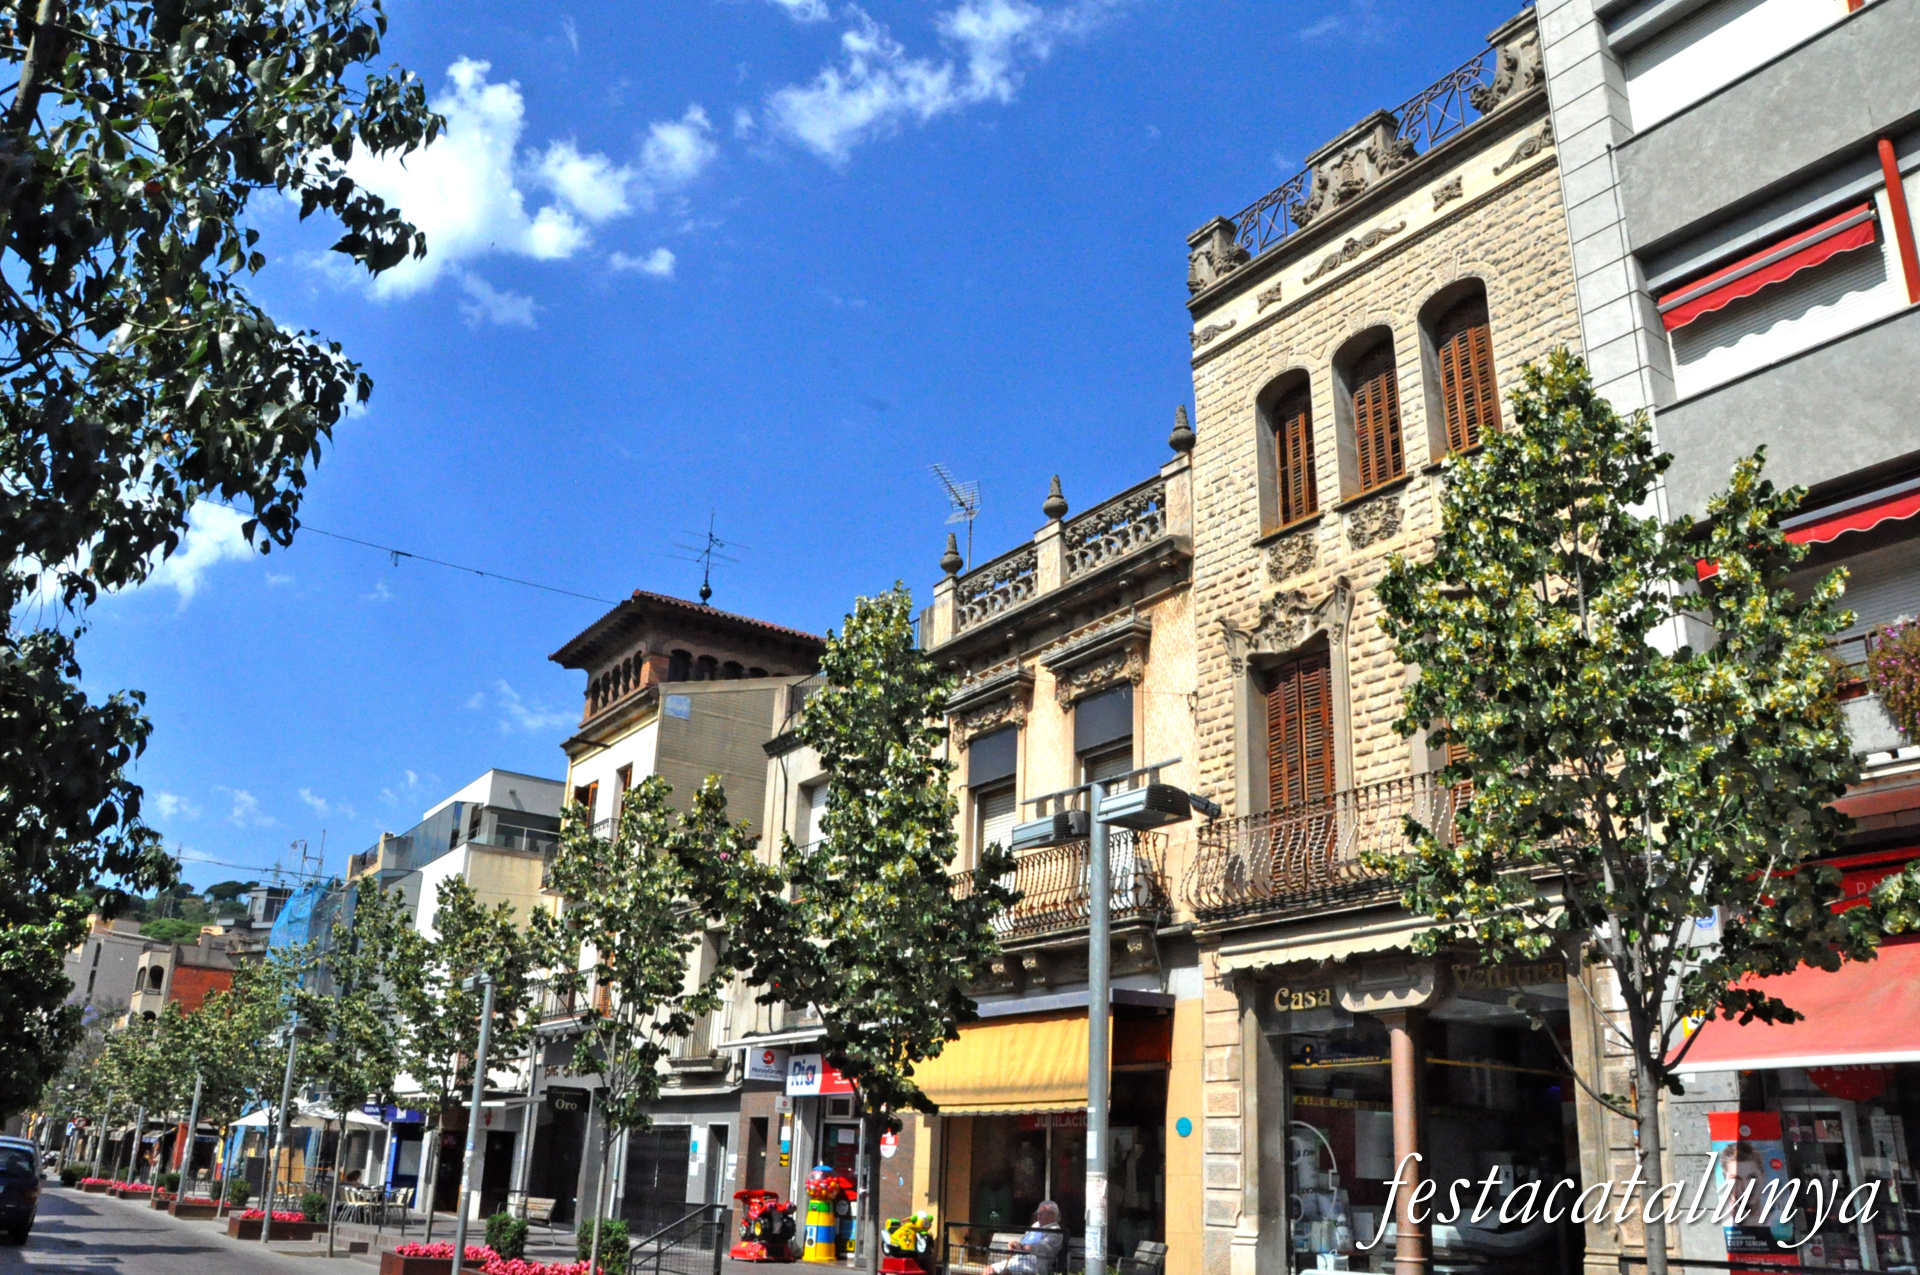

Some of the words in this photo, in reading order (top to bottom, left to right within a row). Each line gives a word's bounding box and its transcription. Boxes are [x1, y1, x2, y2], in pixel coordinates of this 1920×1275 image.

[1274, 986, 1332, 1012] Casa
[791, 1059, 817, 1087] Ria
[555, 1098, 578, 1110] Oro
